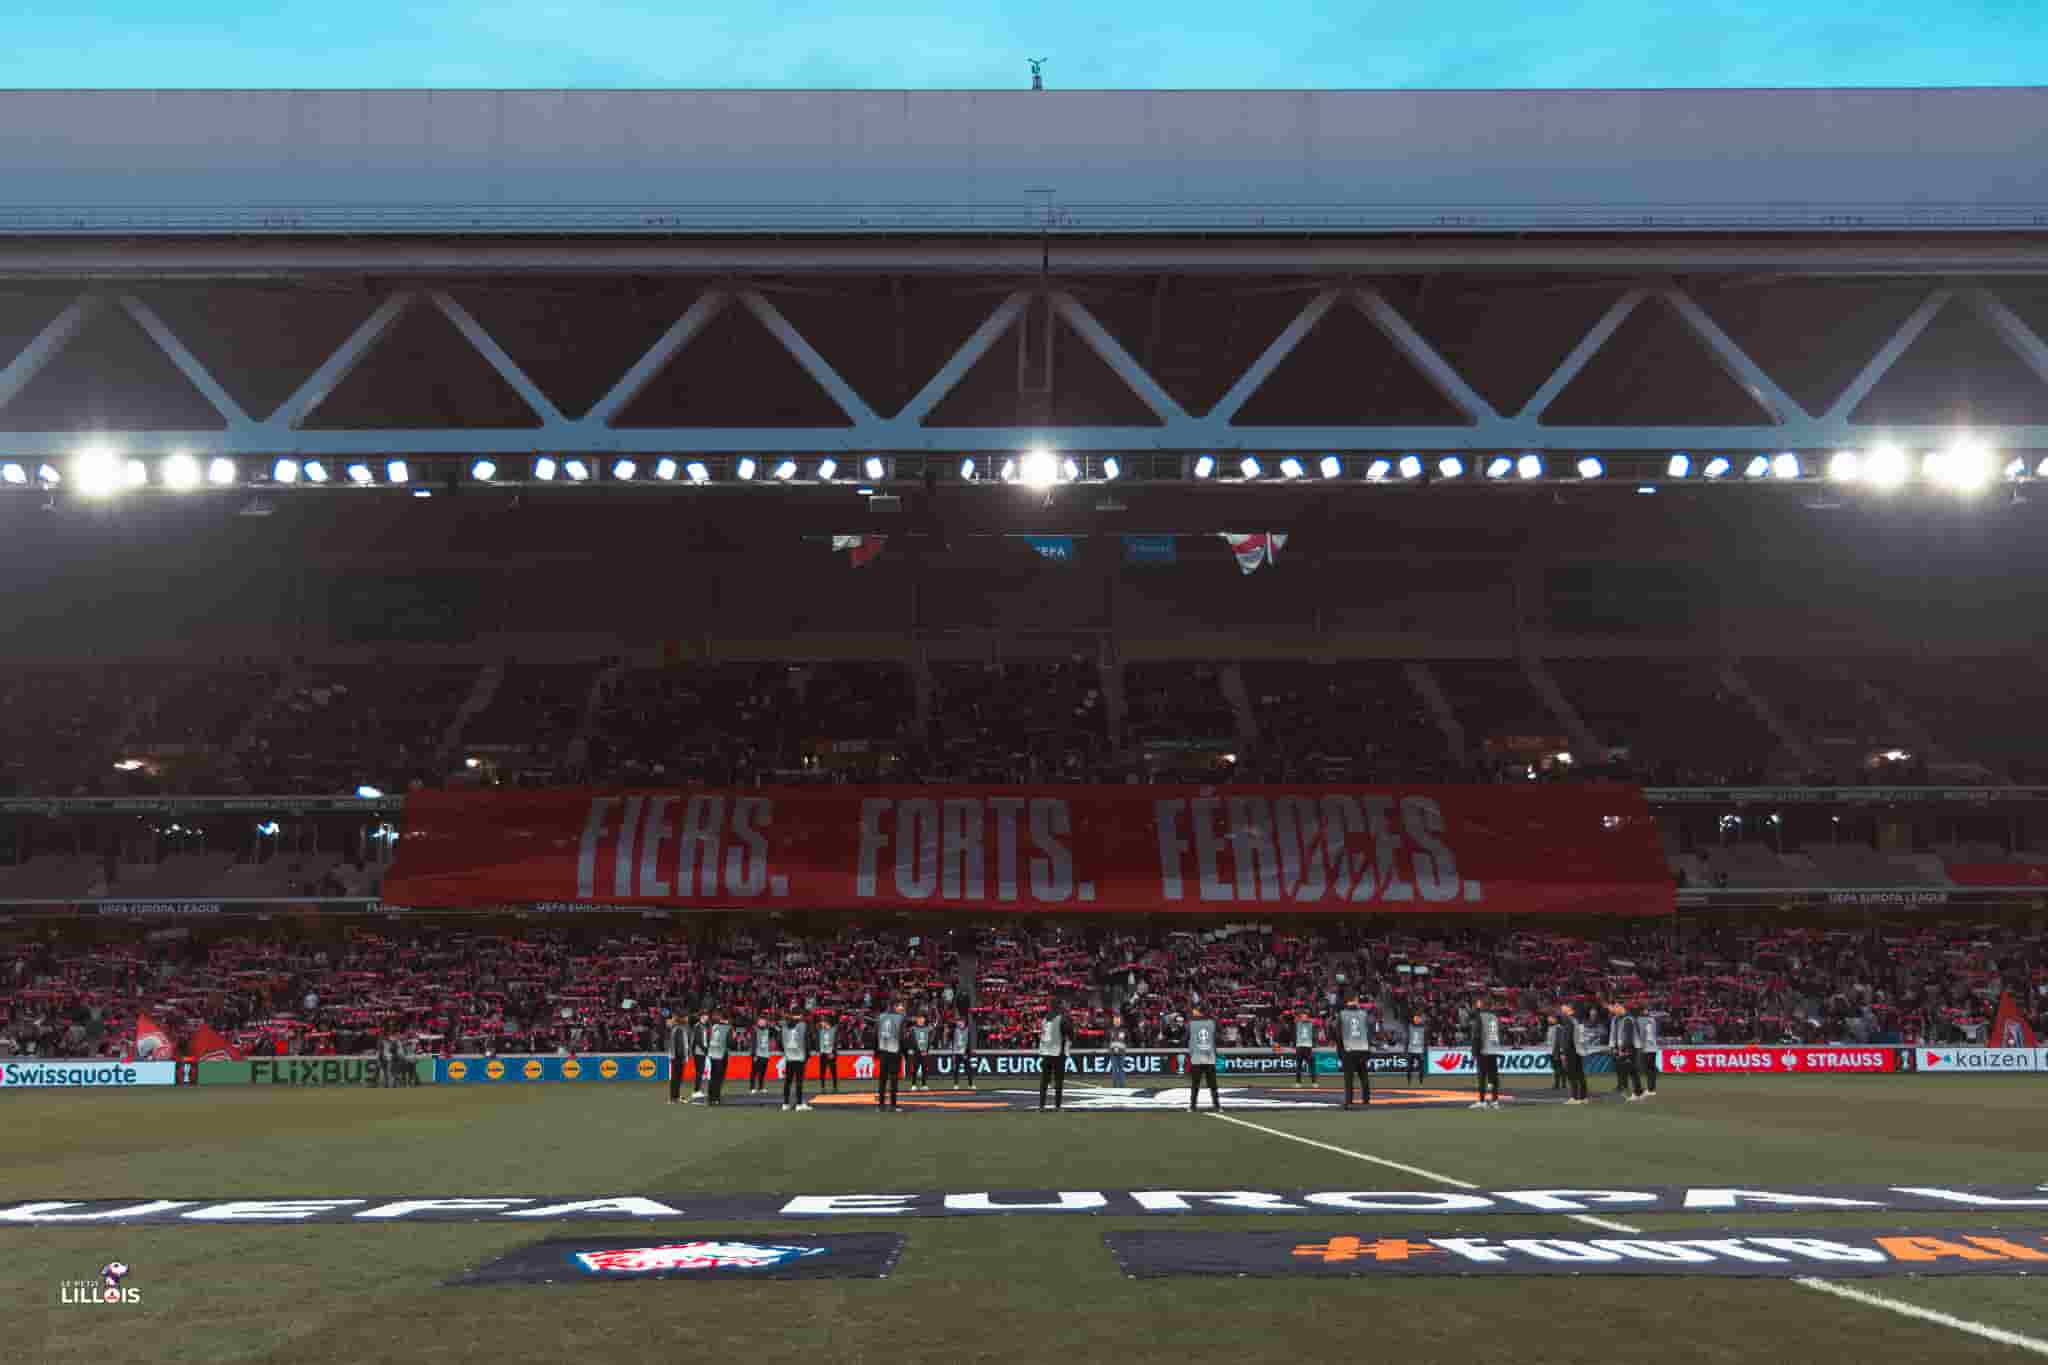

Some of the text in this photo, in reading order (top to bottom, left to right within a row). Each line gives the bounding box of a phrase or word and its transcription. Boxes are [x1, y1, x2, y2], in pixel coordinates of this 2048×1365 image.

[576, 785, 1483, 902] FIERS. FORTS. FÉROCES.
[1695, 1053, 1772, 1068] STRAUSS
[1807, 1052, 1883, 1067] STRAUSS
[1955, 1050, 2028, 1067] kaizen
[6, 1063, 137, 1087] Swissquote
[0, 1198, 686, 1218] UEFA
[779, 1190, 1888, 1214] EUROPA
